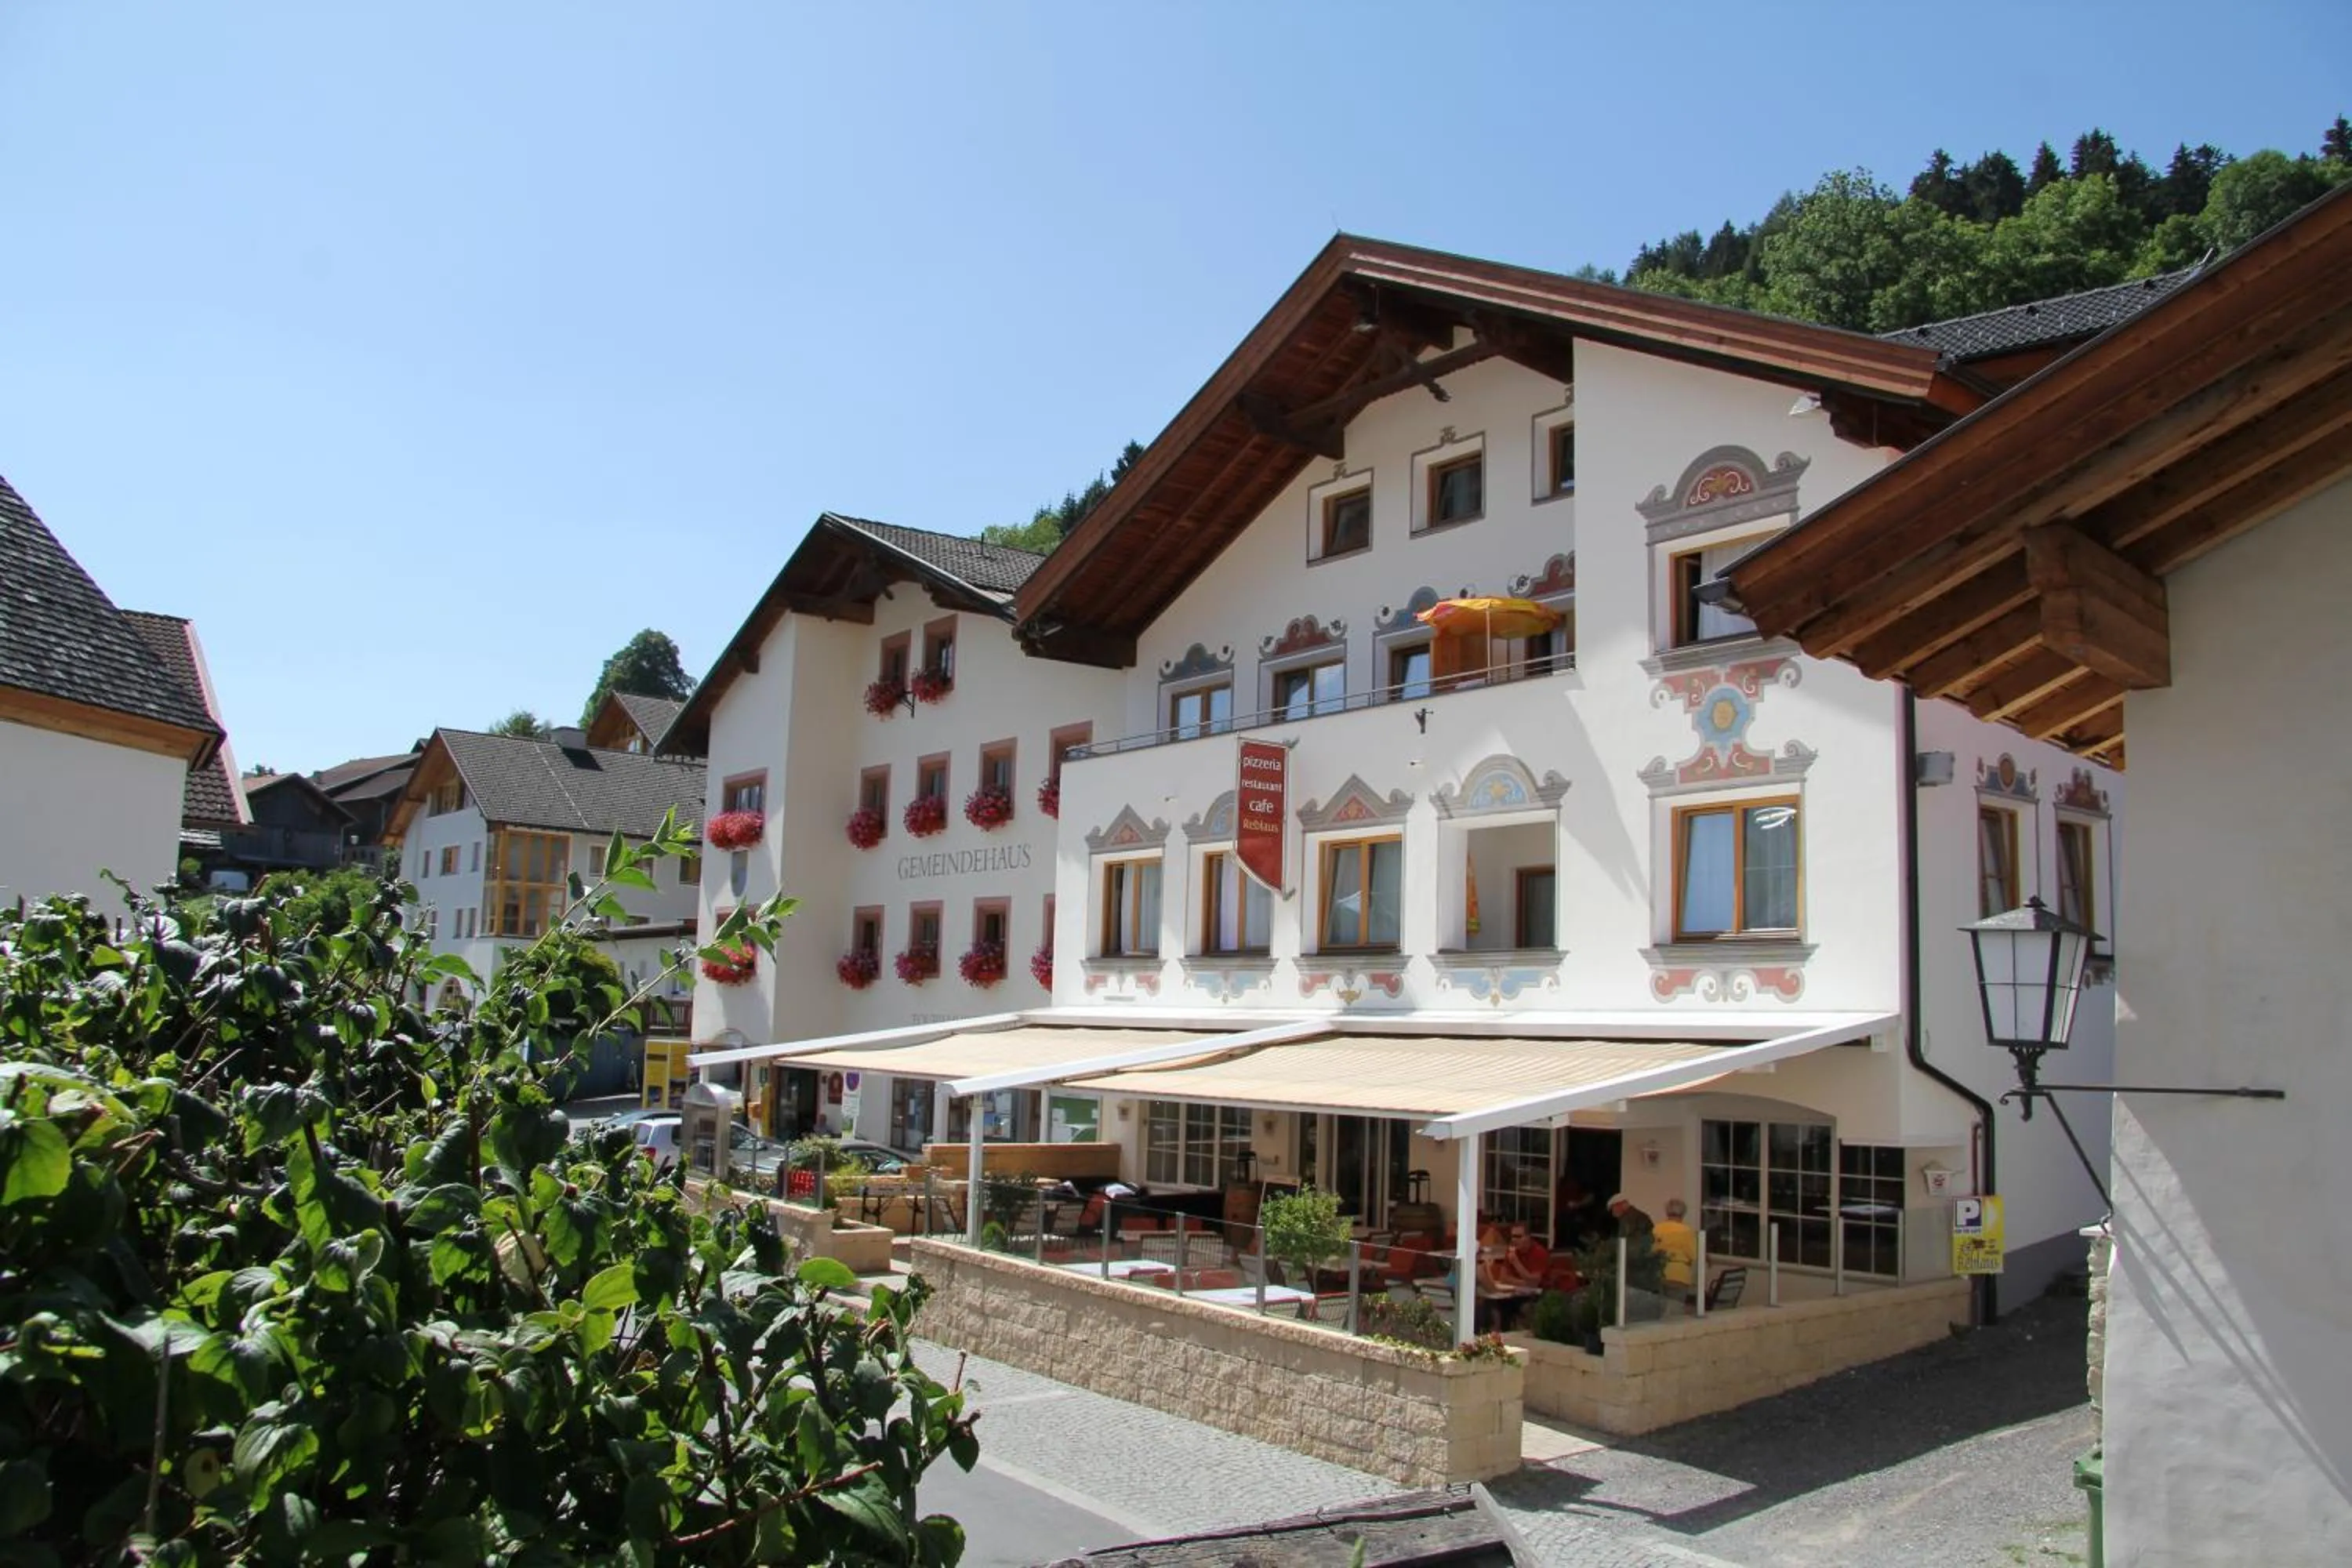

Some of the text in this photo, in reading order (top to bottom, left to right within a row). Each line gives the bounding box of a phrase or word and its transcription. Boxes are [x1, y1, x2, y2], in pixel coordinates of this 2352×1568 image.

[1243, 757, 1281, 770] pizzeria
[1241, 780, 1282, 792] restaurant
[1249, 800, 1273, 813] cafe
[898, 844, 1031, 880] GEMEINDEHAUS
[1956, 1199, 1980, 1226] P
